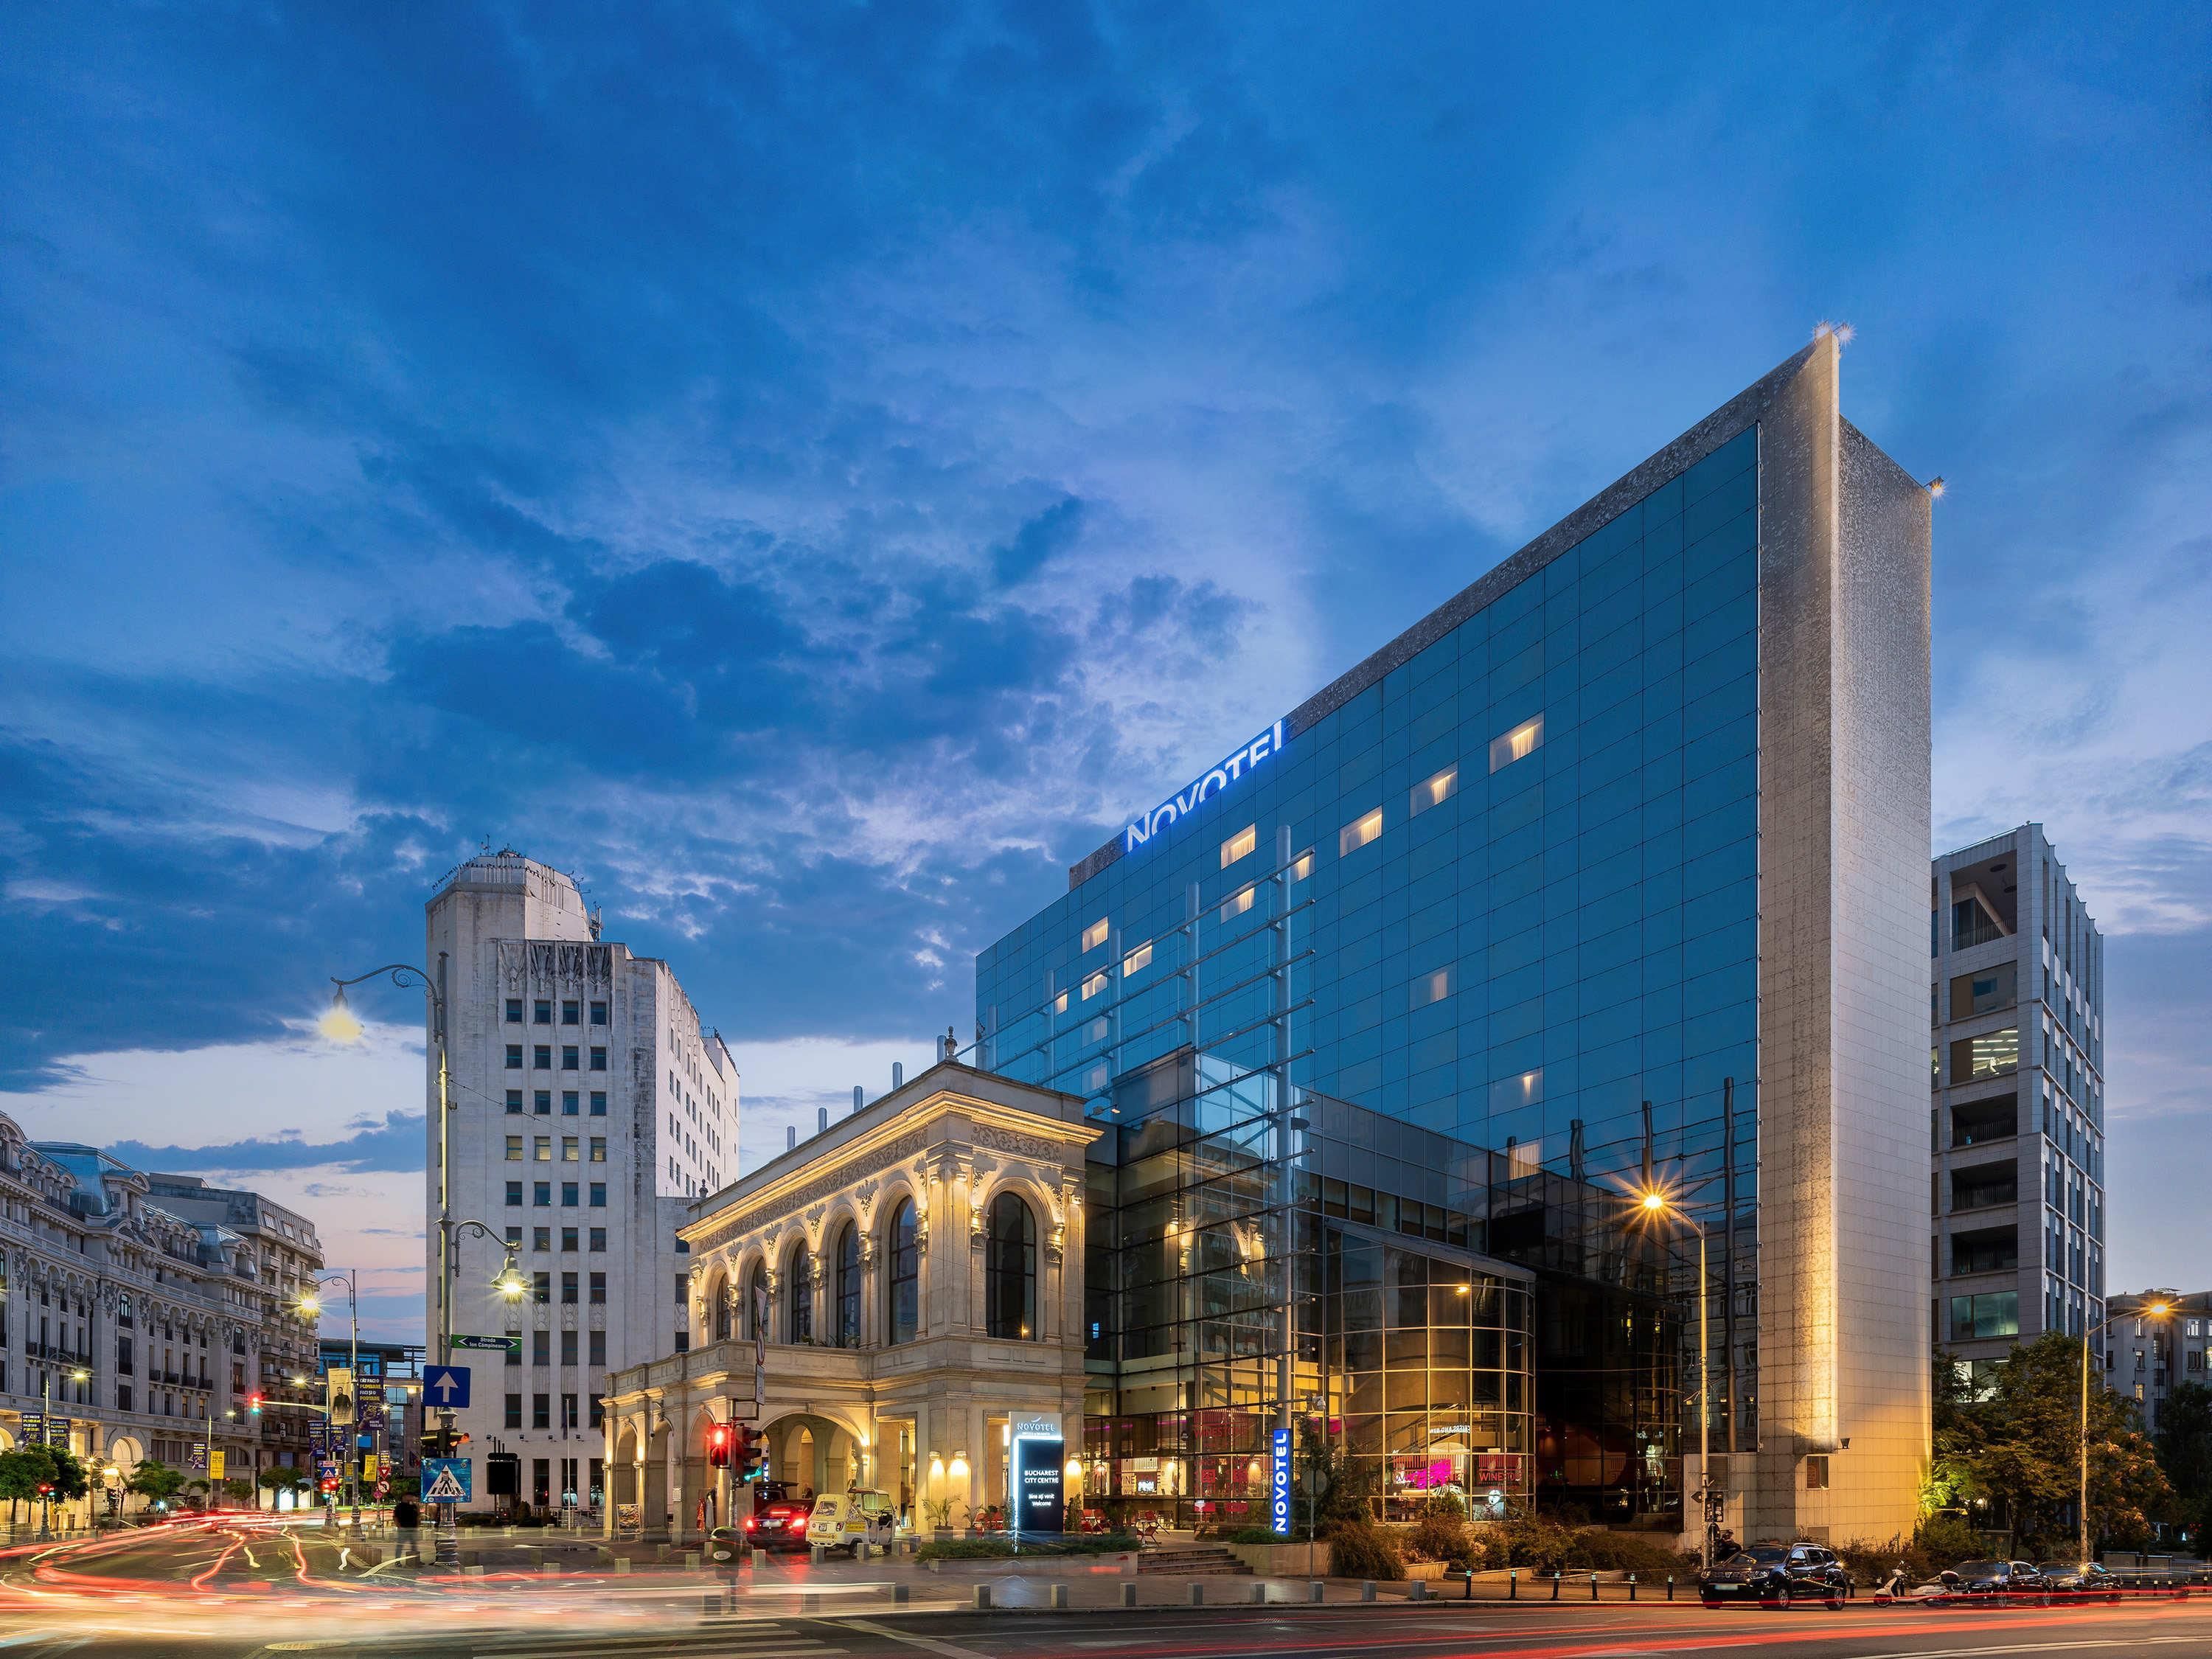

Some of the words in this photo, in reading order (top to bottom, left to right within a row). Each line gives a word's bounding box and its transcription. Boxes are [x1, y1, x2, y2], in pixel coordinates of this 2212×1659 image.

[1127, 719, 1282, 852] NOVOTEL
[1017, 1422, 1056, 1432] NOVOTEL
[1275, 1433, 1287, 1532] NOVOTEL
